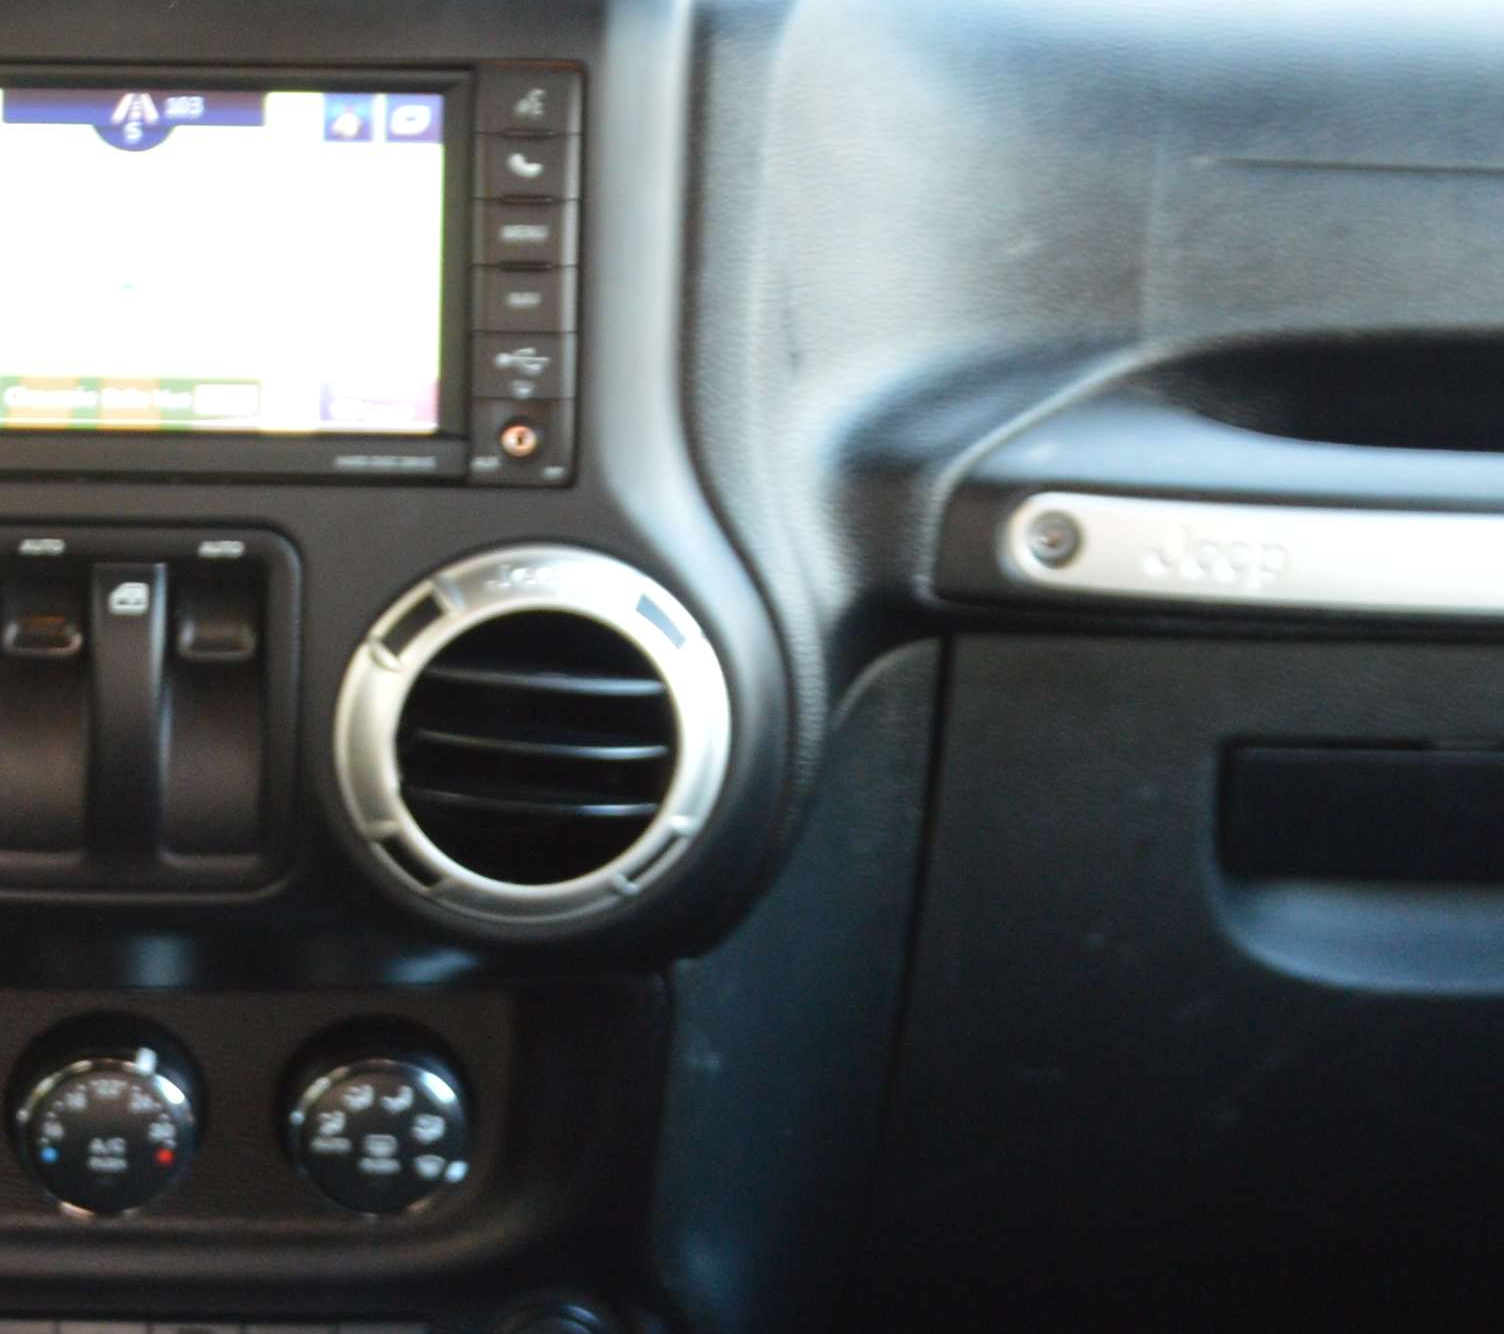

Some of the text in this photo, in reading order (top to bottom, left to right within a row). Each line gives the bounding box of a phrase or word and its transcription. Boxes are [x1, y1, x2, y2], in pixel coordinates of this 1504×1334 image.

[19, 539, 65, 555] AUTO
[198, 540, 244, 557] AUTO
[1142, 523, 1291, 591] Jeep
[89, 1137, 126, 1155] A/C
